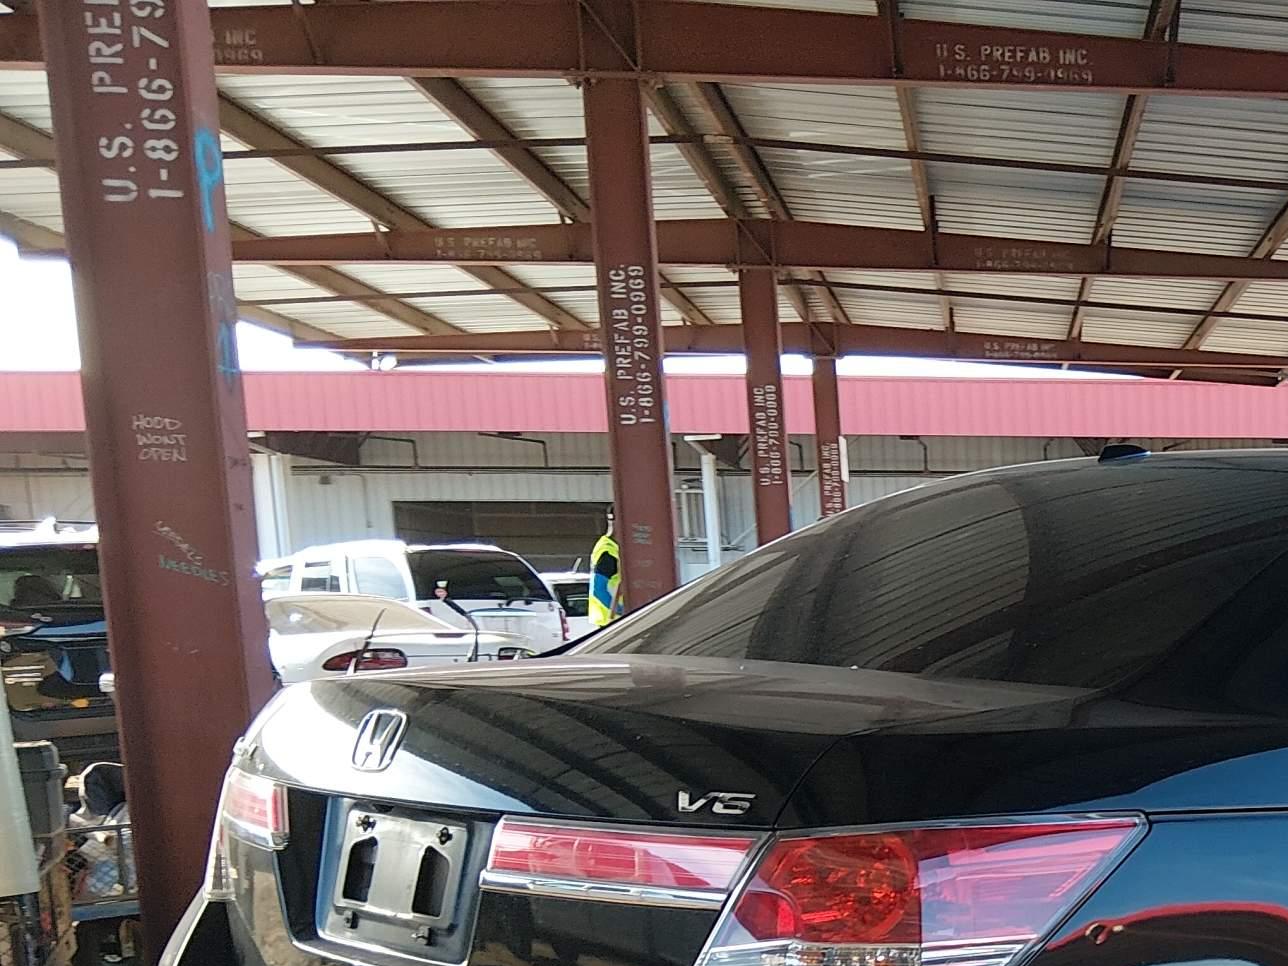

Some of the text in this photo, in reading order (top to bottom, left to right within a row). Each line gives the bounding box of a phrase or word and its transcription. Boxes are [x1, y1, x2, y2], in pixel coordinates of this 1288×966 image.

[980, 45, 1050, 64] PREFAB
[83, 0, 139, 202] U.S. PRE
[609, 264, 637, 425] U.S. PREFAB INC.
[132, 414, 183, 430] HOOD
[138, 448, 188, 462] OPEN
[678, 790, 756, 815] V6
